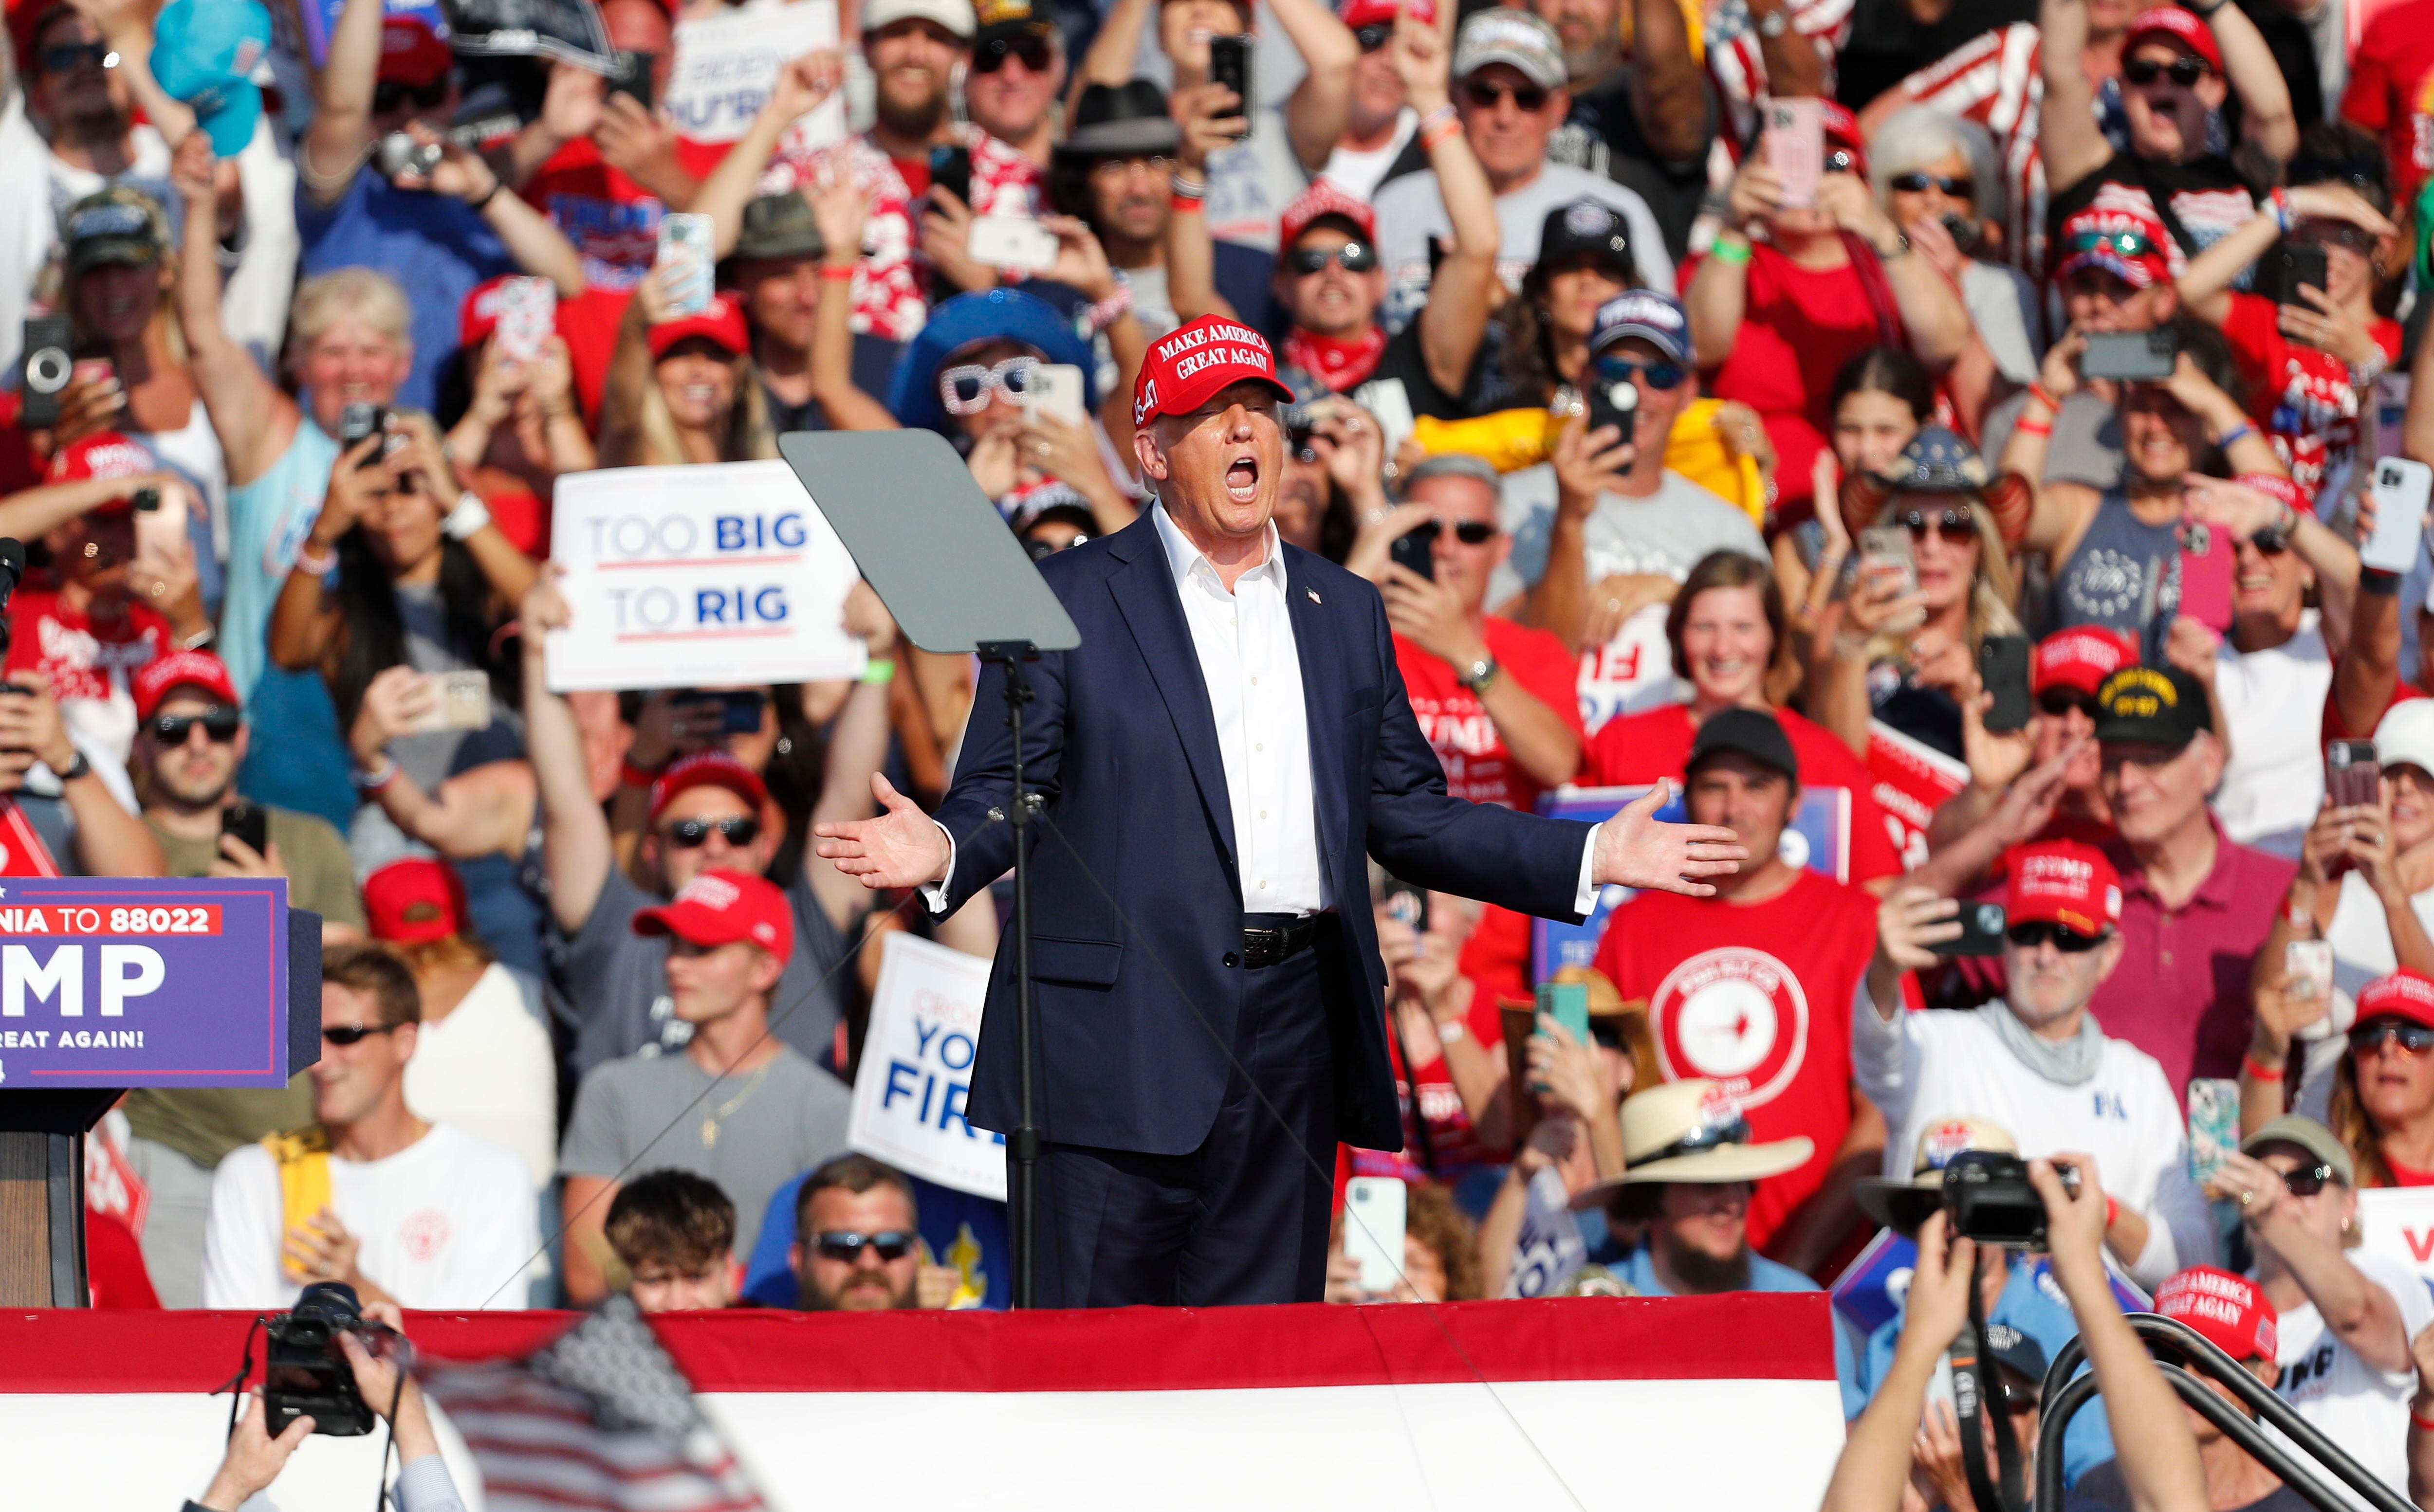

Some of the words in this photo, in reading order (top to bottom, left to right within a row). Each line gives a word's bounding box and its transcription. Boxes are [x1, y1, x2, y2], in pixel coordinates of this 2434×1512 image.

[1158, 328, 1207, 362] MAKE
[1209, 325, 1271, 354] AMERICA
[1177, 347, 1227, 380] GREAT
[1231, 347, 1267, 373] AGAIN
[588, 515, 697, 556] TOO
[716, 513, 806, 550] BIG
[609, 587, 678, 627] TO
[697, 587, 788, 623] RIG
[0, 908, 50, 933] NIA
[57, 908, 101, 933] TO
[110, 908, 209, 933] 88022
[2, 944, 166, 1017] MP
[0, 1030, 50, 1048] EAT
[57, 1030, 145, 1048] AGAIN!
[915, 1016, 975, 1070] YO
[884, 1059, 1006, 1146] FIR
[2189, 1270, 2252, 1310] AMERICA
[2193, 1294, 2242, 1328] AGAIN
